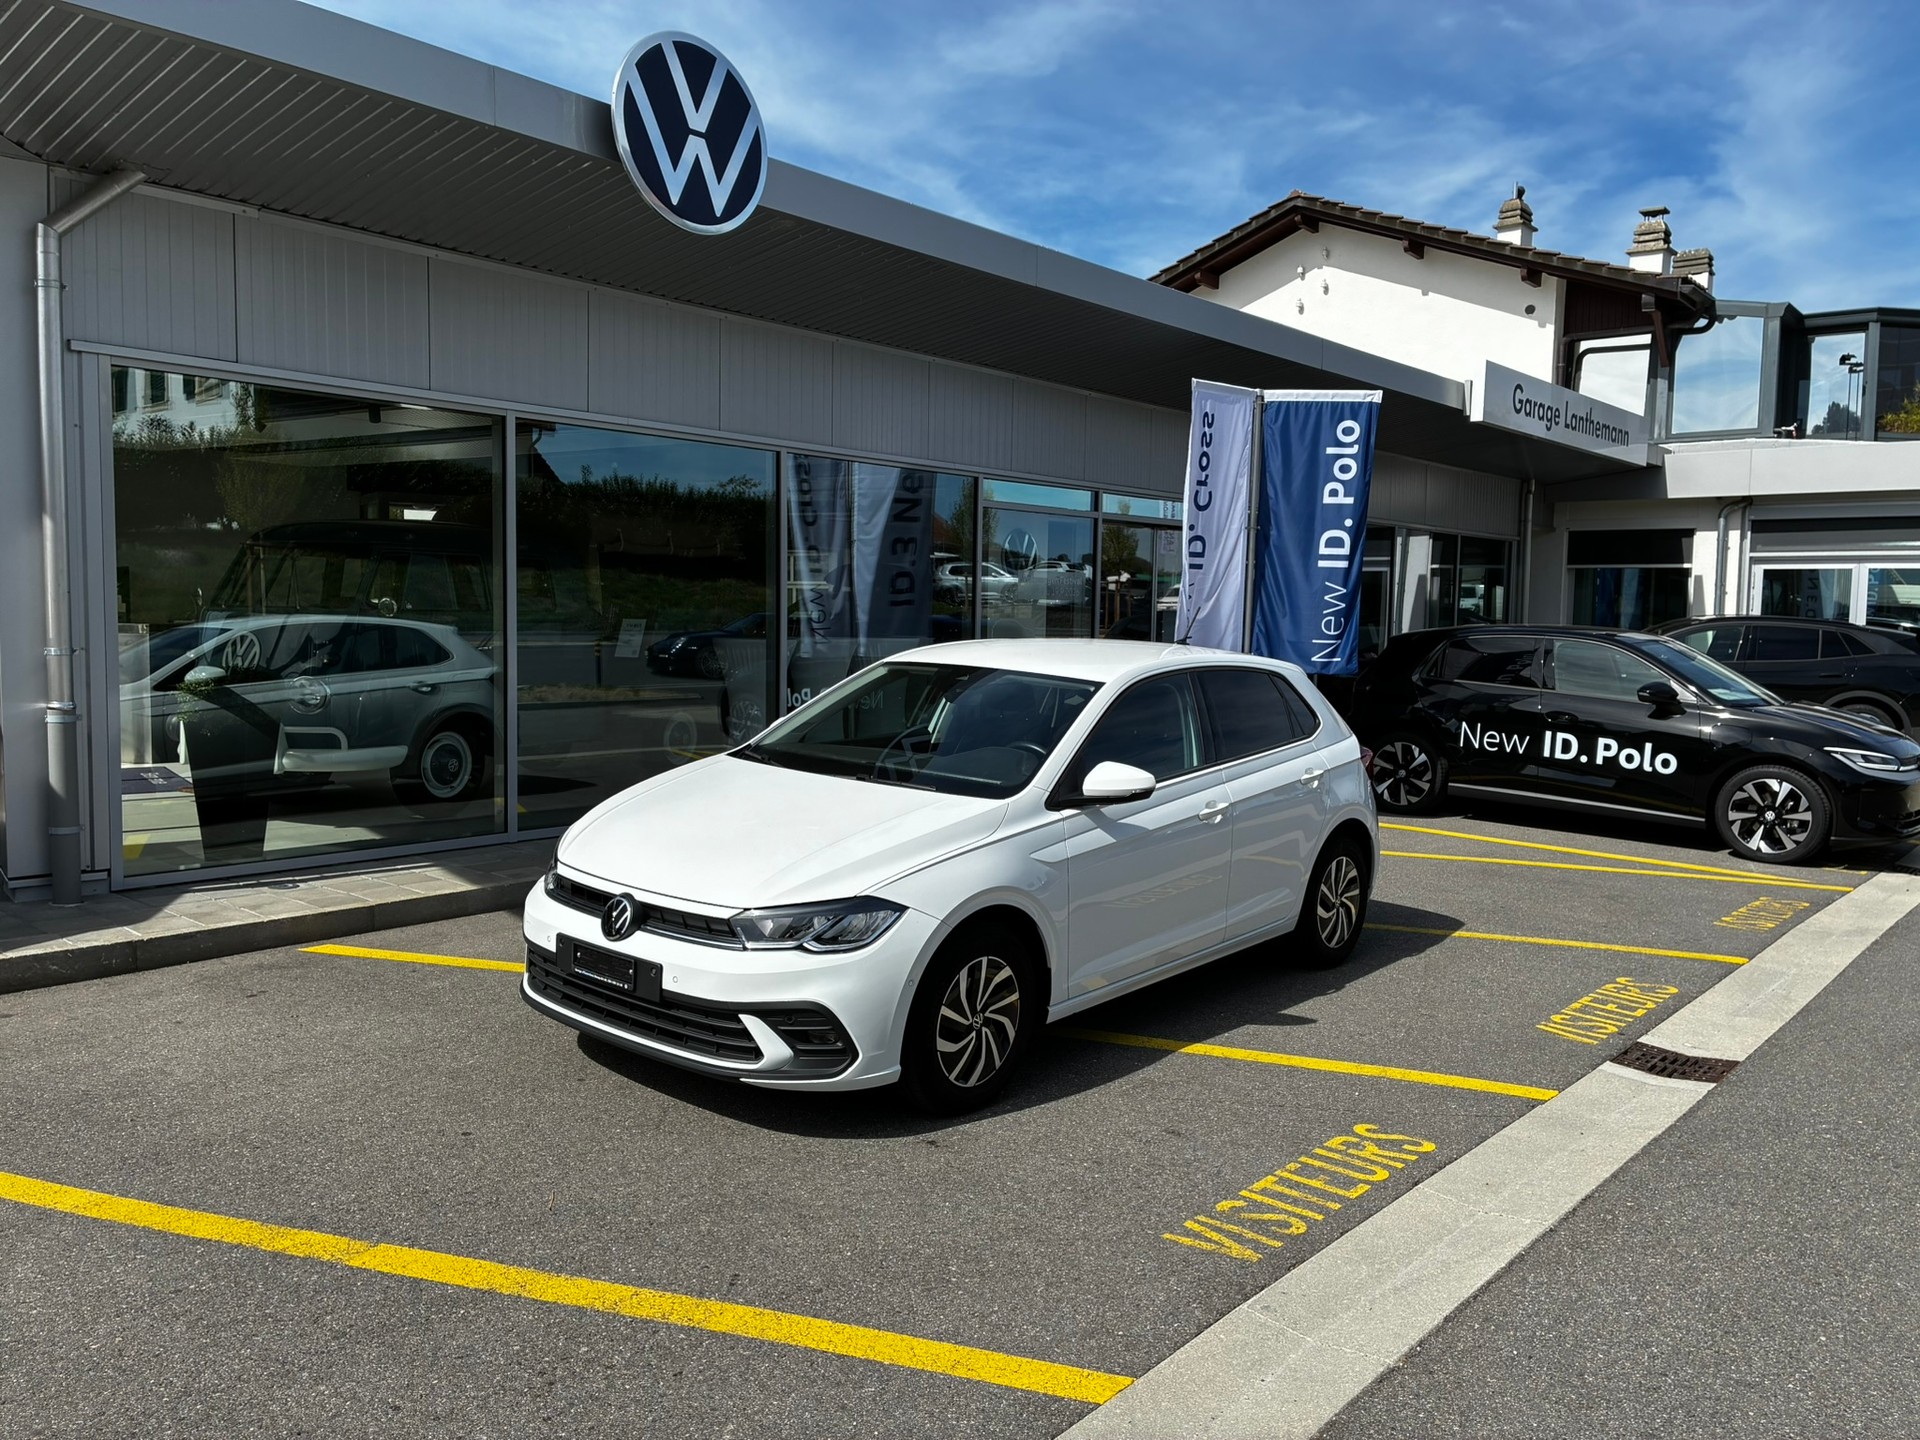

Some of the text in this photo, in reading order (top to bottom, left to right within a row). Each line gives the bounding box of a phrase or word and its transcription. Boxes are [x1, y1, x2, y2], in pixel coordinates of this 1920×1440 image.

[1513, 383, 1630, 447] Garage Lanthemann
[1311, 419, 1361, 662] New ID. Polo
[1460, 721, 1678, 775] New ID. Polo
[1160, 1123, 1436, 1263] VISITEURS
